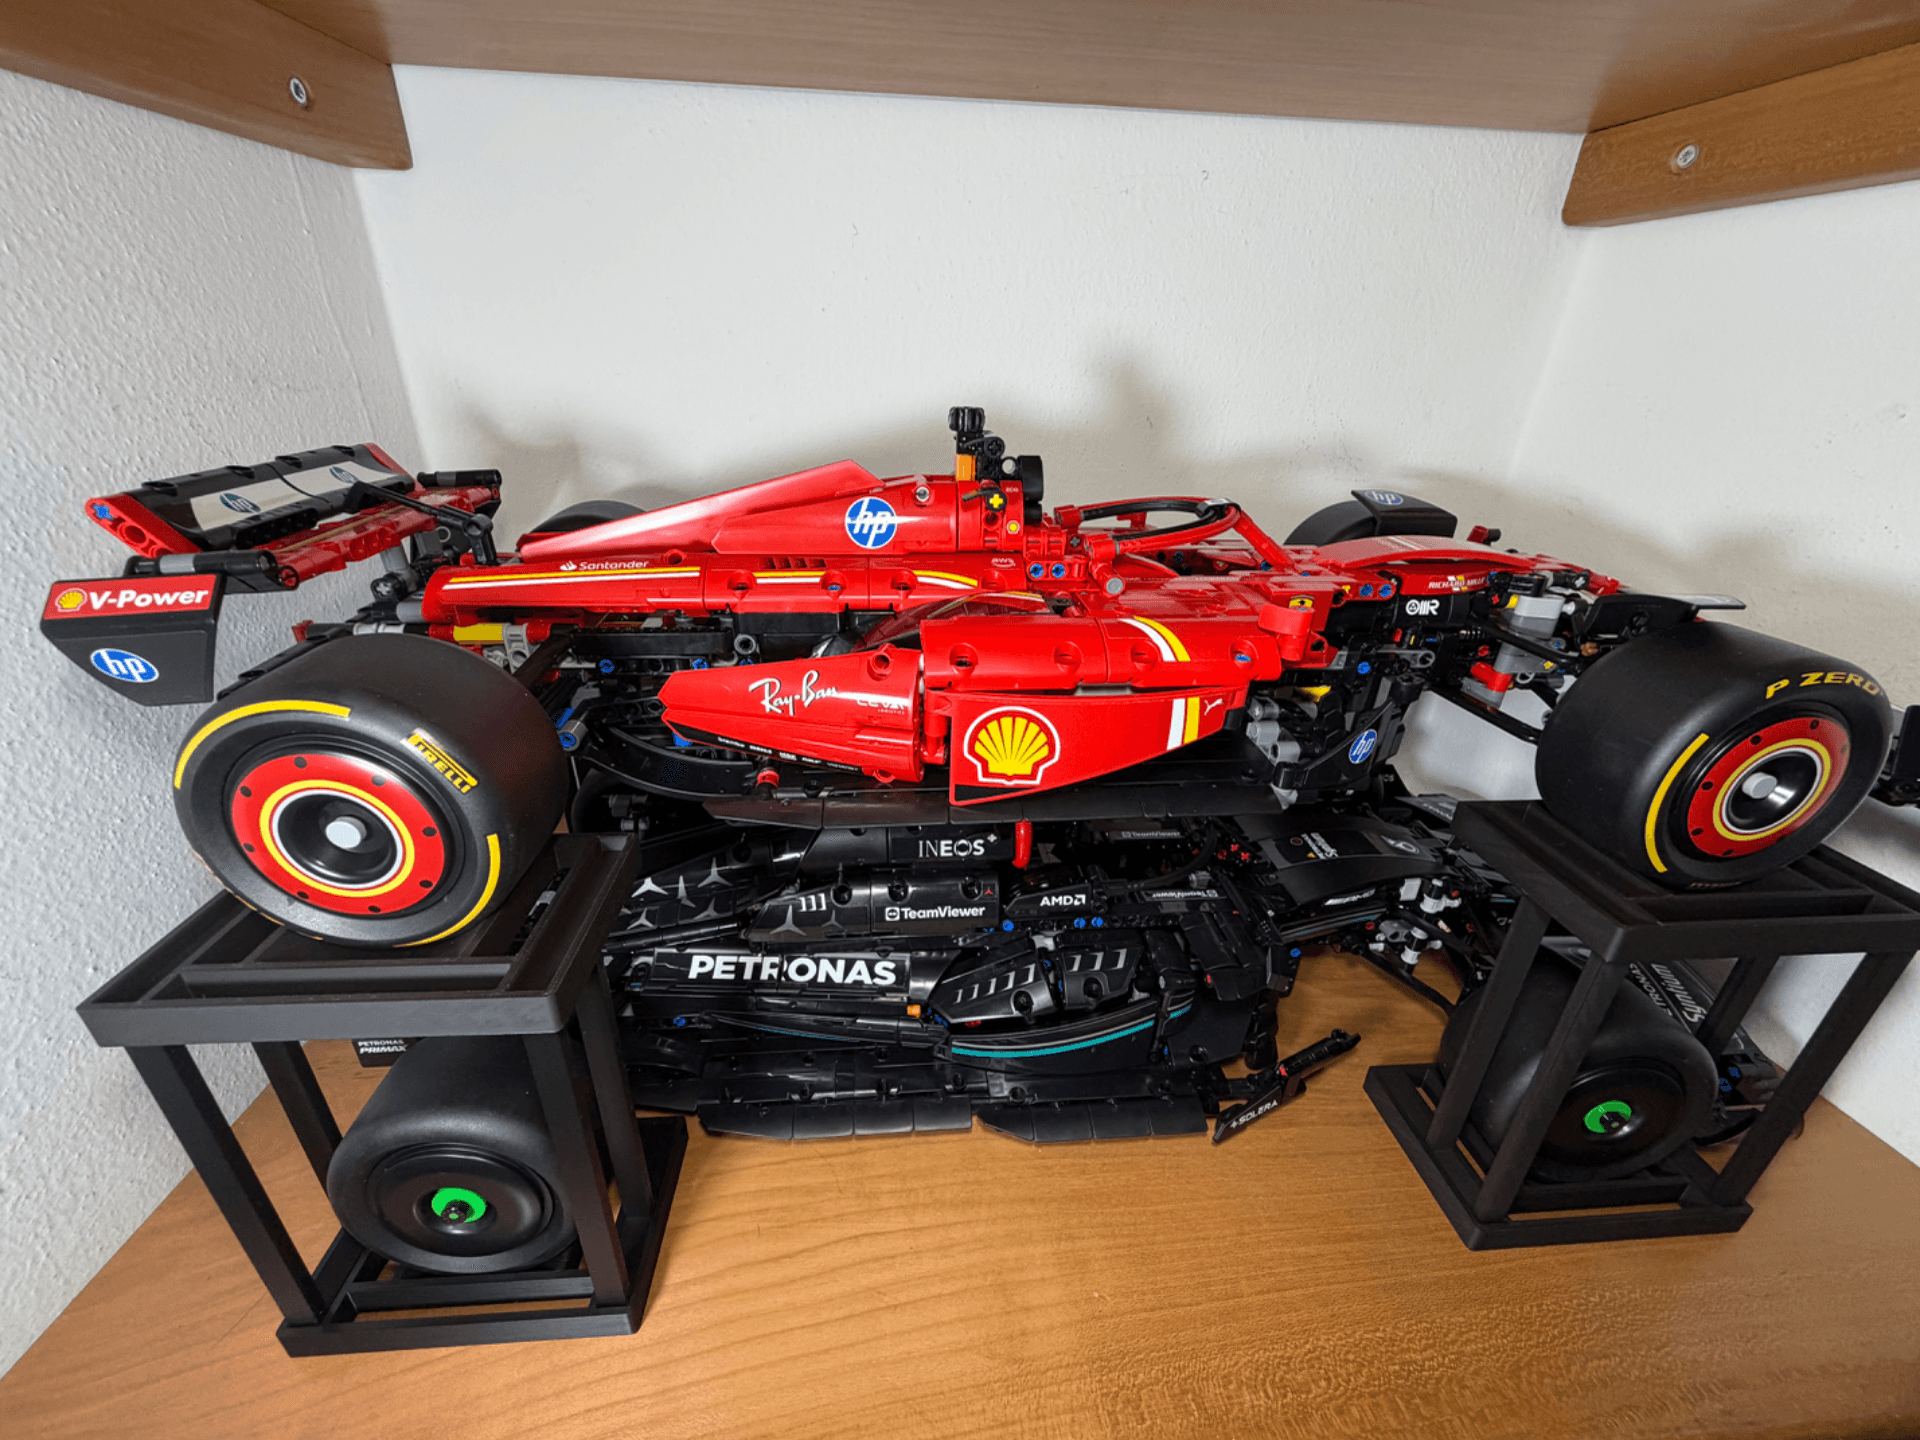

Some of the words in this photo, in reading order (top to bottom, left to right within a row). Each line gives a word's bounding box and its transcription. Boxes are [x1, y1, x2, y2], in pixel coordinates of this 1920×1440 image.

[1369, 489, 1399, 505] hp
[848, 497, 894, 549] hp
[579, 561, 649, 570] Santander
[89, 589, 209, 610] V-Power
[97, 649, 151, 682] hp
[749, 670, 838, 716] Ray-Ban
[1765, 679, 1790, 699] P
[1799, 671, 1880, 695] ZERO
[1350, 730, 1376, 763] hp
[407, 734, 478, 793] PIRELLI
[918, 839, 985, 857] INEOS
[901, 906, 986, 919] TeamViewer
[1040, 894, 1074, 906] AMD
[688, 955, 897, 985] PETRONAS
[358, 1039, 404, 1047] PETRONAS
[1239, 1100, 1278, 1125] SOLERA
